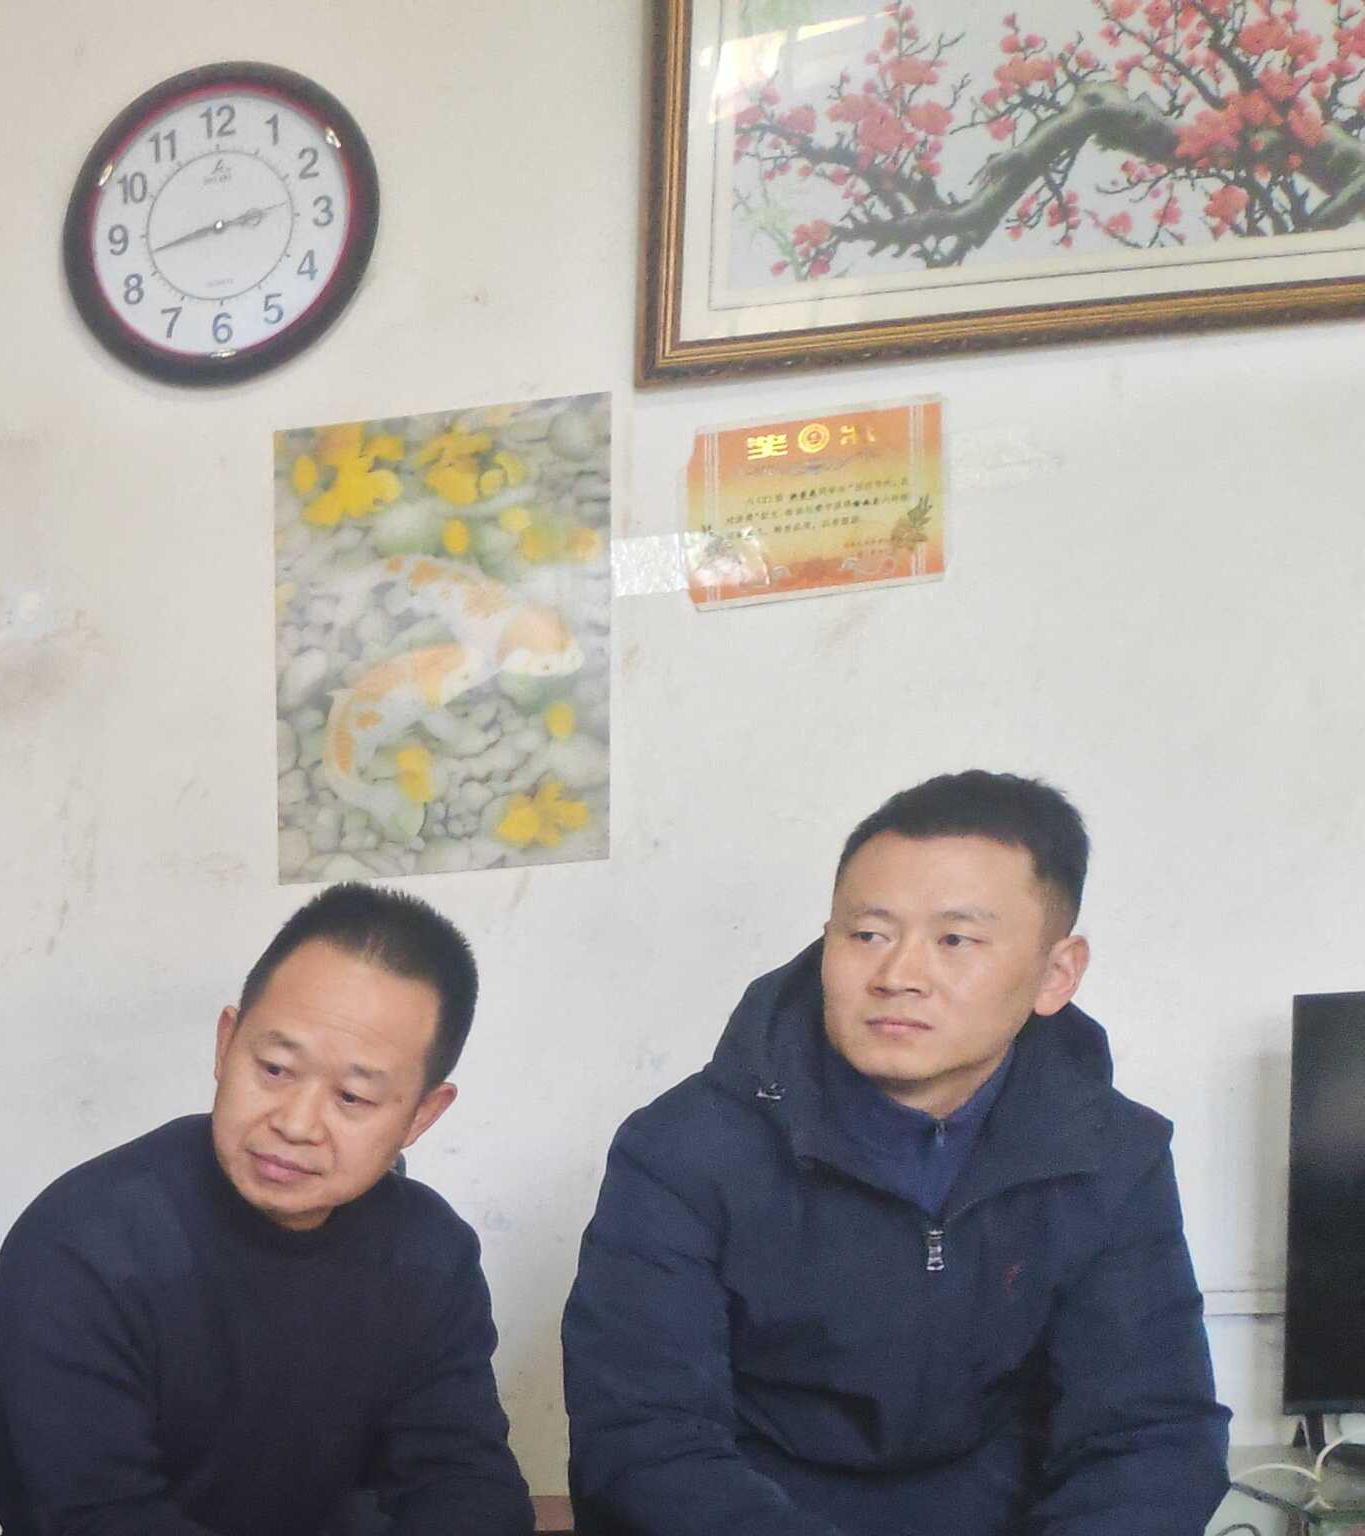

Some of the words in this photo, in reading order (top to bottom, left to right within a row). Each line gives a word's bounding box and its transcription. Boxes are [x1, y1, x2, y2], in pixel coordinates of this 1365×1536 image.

[200, 105, 236, 138] 12
[265, 113, 280, 145] 1
[149, 129, 177, 163] 11
[298, 147, 319, 180] 2
[118, 172, 147, 204] 10
[312, 195, 334, 227] 3
[108, 224, 129, 256] 9
[296, 249, 317, 281] 4
[123, 273, 144, 305] 8
[161, 307, 182, 338] 7
[263, 293, 284, 324] 5
[212, 312, 233, 343] 6
